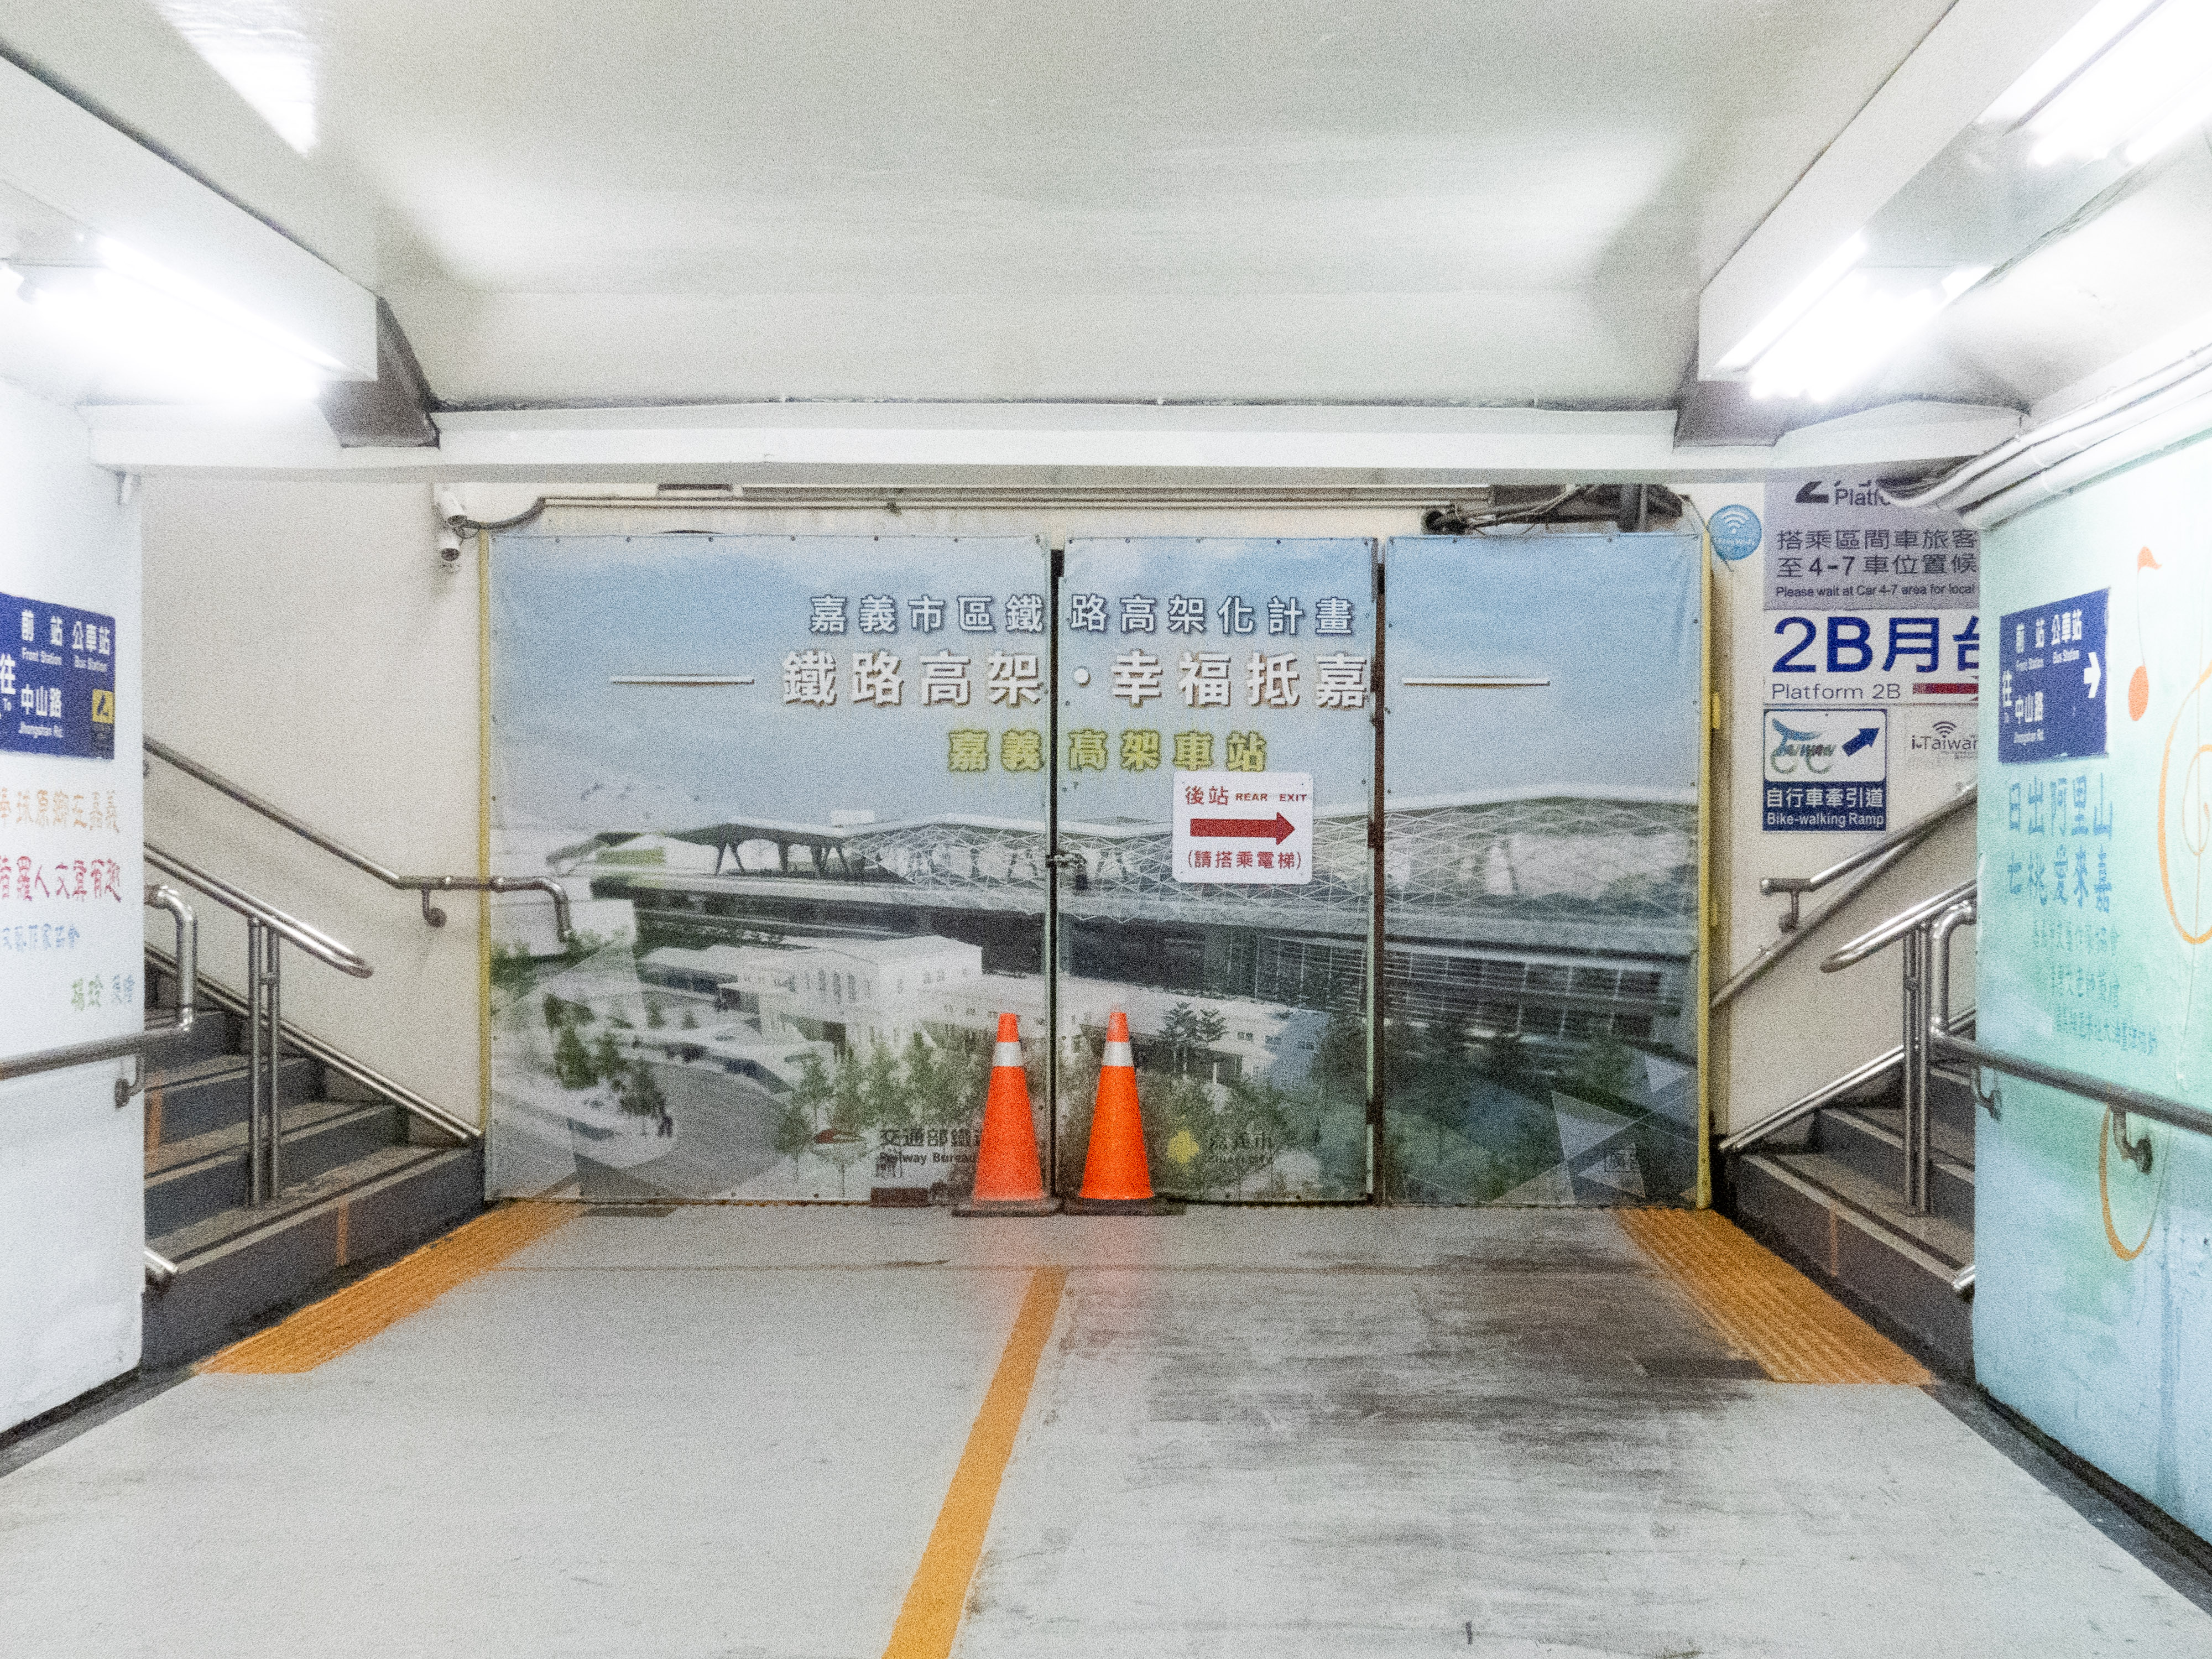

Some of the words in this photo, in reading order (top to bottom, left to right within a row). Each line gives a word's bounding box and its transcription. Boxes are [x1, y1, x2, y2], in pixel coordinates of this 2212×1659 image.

[1777, 528, 1978, 551] 搭乘區間車旅客
[1777, 553, 1978, 578] 至4-7車位置候
[1776, 586, 1814, 597] Please
[1816, 585, 1839, 597] wait
[1842, 586, 1854, 597] at
[1856, 585, 1877, 597] Car
[1879, 583, 1898, 596] 4-7
[1901, 585, 1927, 596] area
[1929, 583, 1945, 594] for
[1948, 583, 1976, 595] local
[810, 593, 1353, 635] 嘉義市區鐵路高架化計畫
[72, 620, 111, 655] 公車站
[2051, 609, 2083, 645] 公車站
[21, 684, 62, 718] 中山路
[1772, 683, 1864, 700] Platform
[1872, 683, 1901, 700] 2B
[3, 697, 12, 711] To
[2015, 691, 2043, 724] 中山路
[948, 728, 1266, 773] 嘉義高架車站
[1185, 785, 1229, 806] 後站
[1235, 792, 1268, 801] REAR
[1279, 793, 1307, 802] EXIT
[1767, 788, 1883, 808] 自行車牽引道
[2008, 773, 2114, 839] 日出阿里山
[1767, 812, 1846, 828] Bike-walking
[1849, 813, 1884, 828] Ramp
[1188, 850, 1302, 870] (請搭乘電梯)
